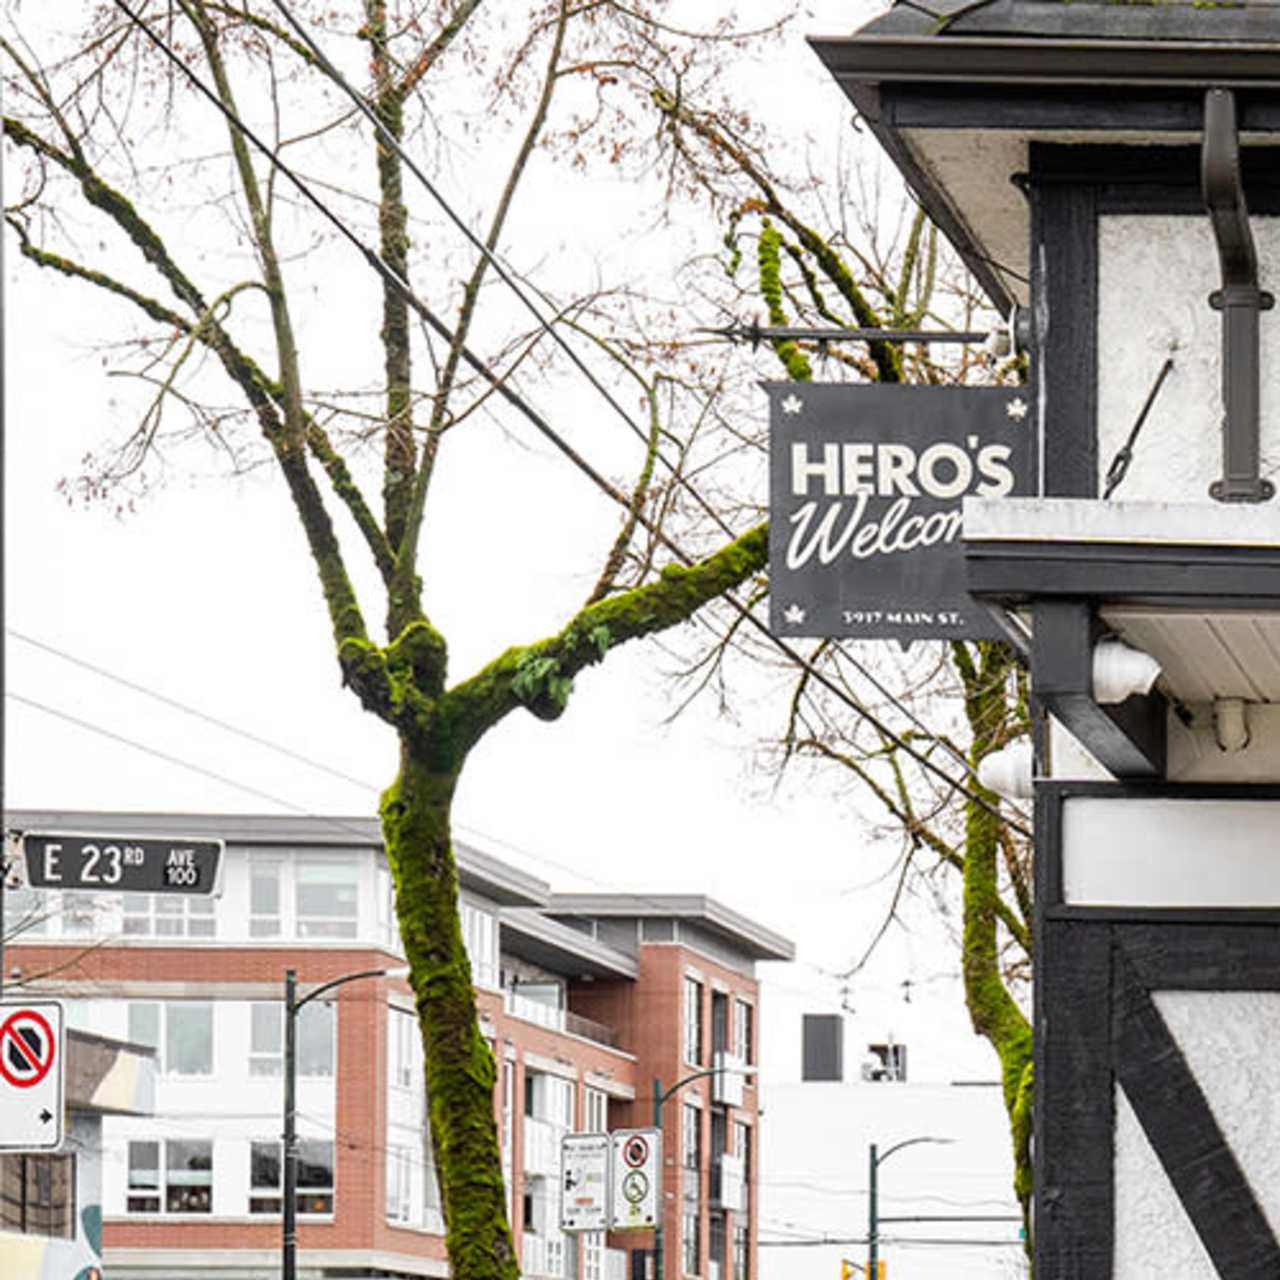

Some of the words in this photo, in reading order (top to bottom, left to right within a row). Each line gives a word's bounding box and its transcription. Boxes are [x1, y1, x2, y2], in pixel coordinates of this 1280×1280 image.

[791, 435, 1015, 498] HERO'S
[886, 611, 933, 624] MAIN
[44, 844, 63, 881] E
[167, 849, 195, 867] AVE
[167, 867, 196, 885] 100
